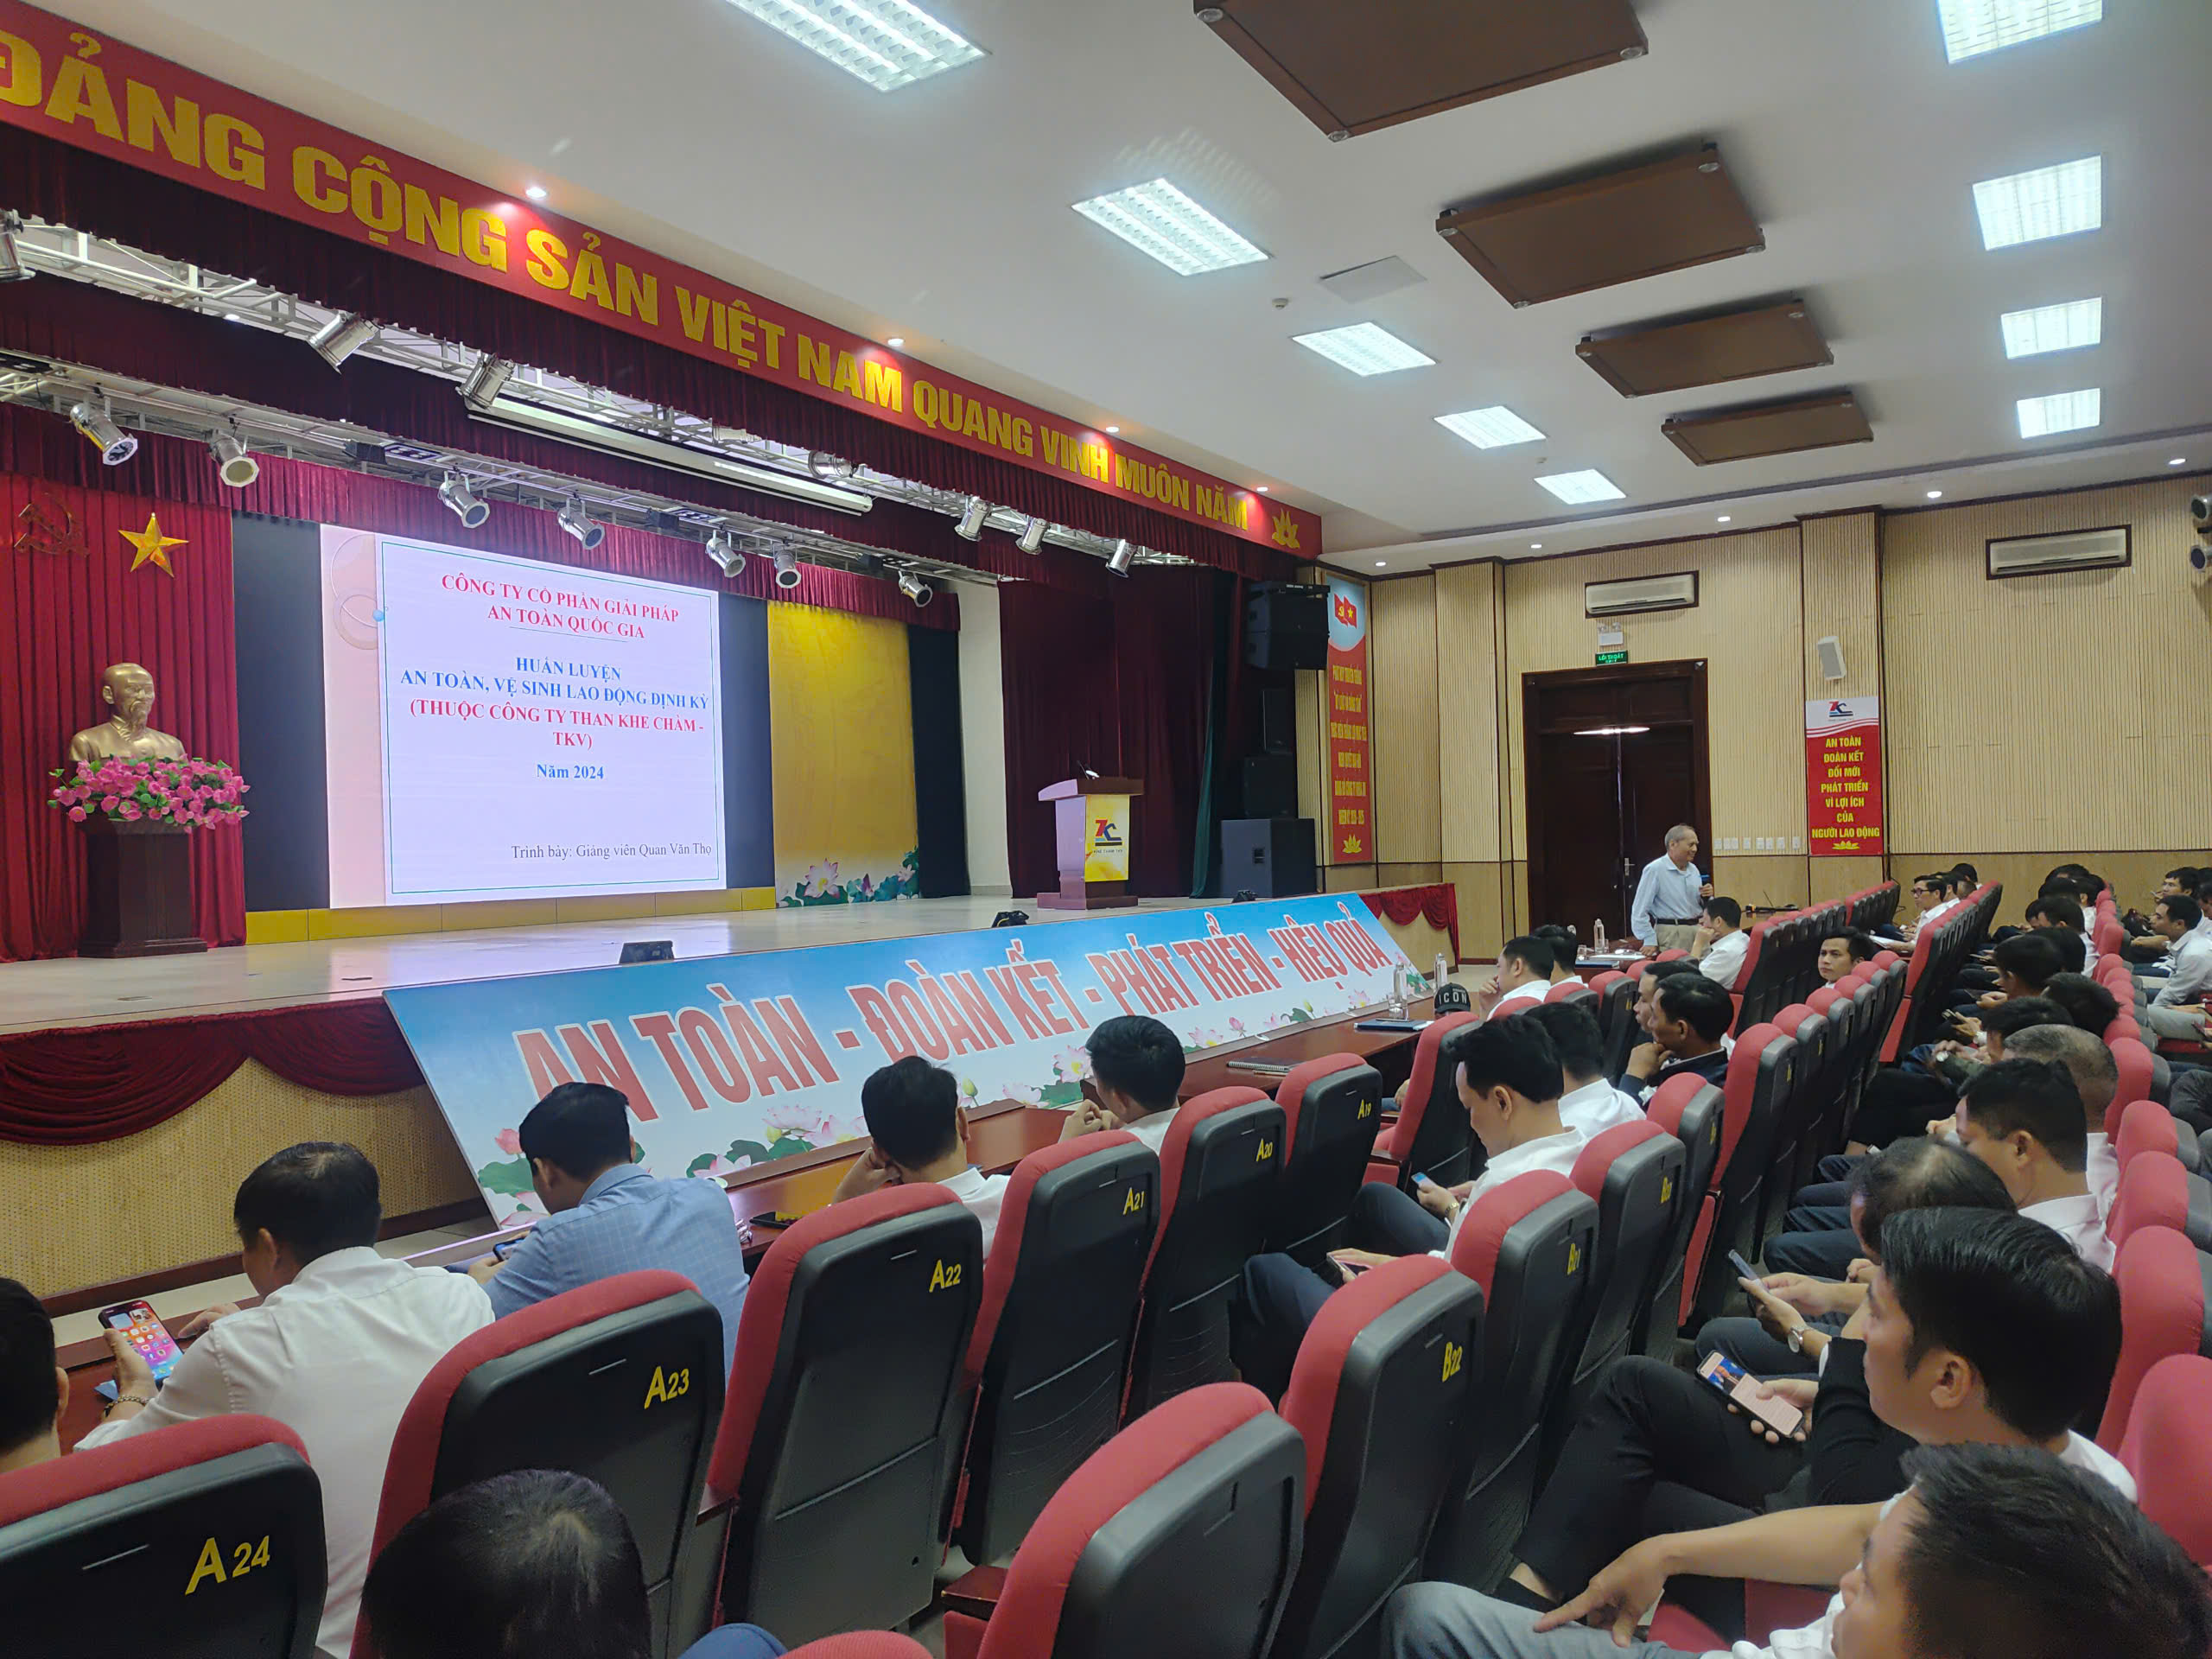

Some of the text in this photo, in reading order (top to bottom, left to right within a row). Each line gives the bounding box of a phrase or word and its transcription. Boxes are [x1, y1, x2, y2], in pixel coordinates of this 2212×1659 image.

[0, 30, 1248, 531] ĐẢNG CỘNG SẢN VIỆT NAM QUANG VINH MUÔN NĂM
[442, 572, 496, 596] CÔNG
[499, 582, 523, 600] TY
[604, 598, 638, 617] GIẢI
[642, 604, 679, 623] PHÁP
[487, 605, 512, 621] AN
[516, 607, 563, 628] TOÀN
[617, 622, 645, 639] GIA
[569, 663, 620, 683] LUYỆN
[401, 670, 427, 685] AN
[433, 671, 490, 694] TOÀN,
[494, 677, 517, 697] VỆ
[522, 681, 561, 697] SINH
[567, 684, 600, 701] LAO
[605, 687, 647, 706] ĐỘNG
[652, 692, 685, 709] ĐỊNH
[410, 699, 485, 721] (THUỘC
[490, 701, 540, 722] CÔNG
[543, 709, 566, 723] TY
[570, 711, 613, 727] THAN
[619, 714, 649, 729] KHE
[653, 715, 696, 732] CHÀM
[552, 732, 593, 750] TKV)
[1825, 736, 1861, 748] AN TOÀN
[1823, 750, 1865, 763] ĐOÀN KẾT
[537, 764, 604, 779] Năm 2024
[1827, 766, 1860, 778] ĐỔI MỚI
[1821, 779, 1869, 793] PHÁT TRIỂN
[1835, 798, 1849, 809] LỢI
[1850, 797, 1865, 808] ÍCH
[1836, 810, 1853, 823] CỦA
[1812, 826, 1880, 839] NGƯỜI LAO ĐỘNG
[512, 842, 712, 861] Trình bày: Giảng viên Quan Văn Thọ
[1439, 991, 1467, 1006] ICON
[514, 1020, 660, 1122] AN
[631, 983, 840, 1111] TOÀN
[847, 959, 1015, 1062] ĐOÀN
[985, 938, 1090, 1039] KẾT
[1087, 933, 1199, 1017] PHÁT
[1172, 912, 1282, 1001] TRIỂN
[1324, 901, 1392, 978] QUẢ
[1357, 1098, 1372, 1121] A19
[1255, 1137, 1273, 1162] A20
[1123, 1185, 1145, 1215] A21
[929, 1259, 962, 1293] A22
[1442, 1341, 1463, 1382] B22
[644, 1365, 690, 1409] A23
[185, 1535, 270, 1595] A24
